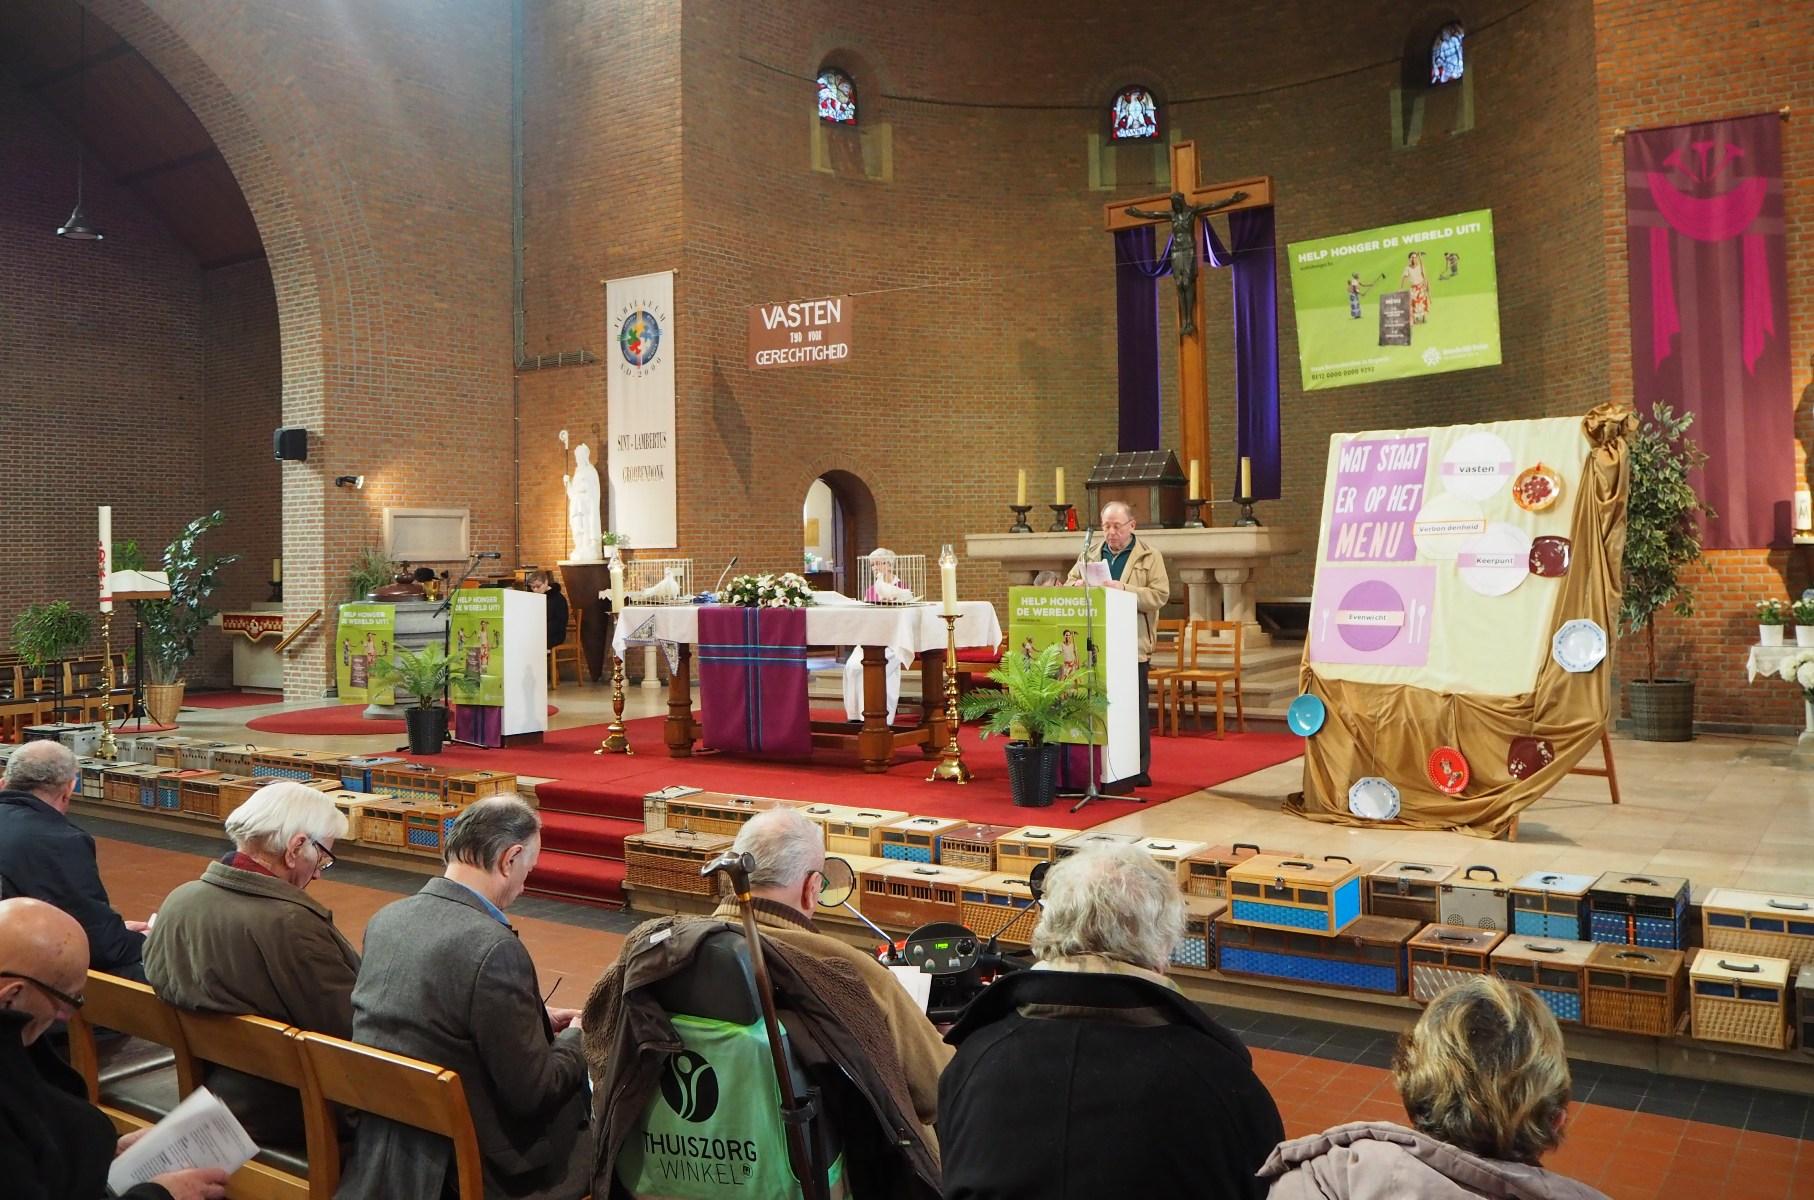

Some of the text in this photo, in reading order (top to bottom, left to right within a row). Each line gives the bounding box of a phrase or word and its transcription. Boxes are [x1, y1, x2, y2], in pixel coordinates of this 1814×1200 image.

[1298, 223, 1481, 263] HELP HONGER DE WERELD UIT!
[761, 299, 841, 330] VASTEN
[756, 343, 848, 365] GERECHTIGHEID
[1340, 442, 1427, 473] WAT STAAT
[1459, 465, 1495, 473] vasten
[1335, 484, 1423, 513] ER OP HET
[1334, 521, 1405, 559] MENU
[1016, 607, 1030, 616] DE
[1033, 607, 1075, 617] WERELD
[1021, 597, 1047, 606] HELP
[642, 1130, 757, 1162] THUISZORG
[659, 1158, 744, 1185] WINKEL
